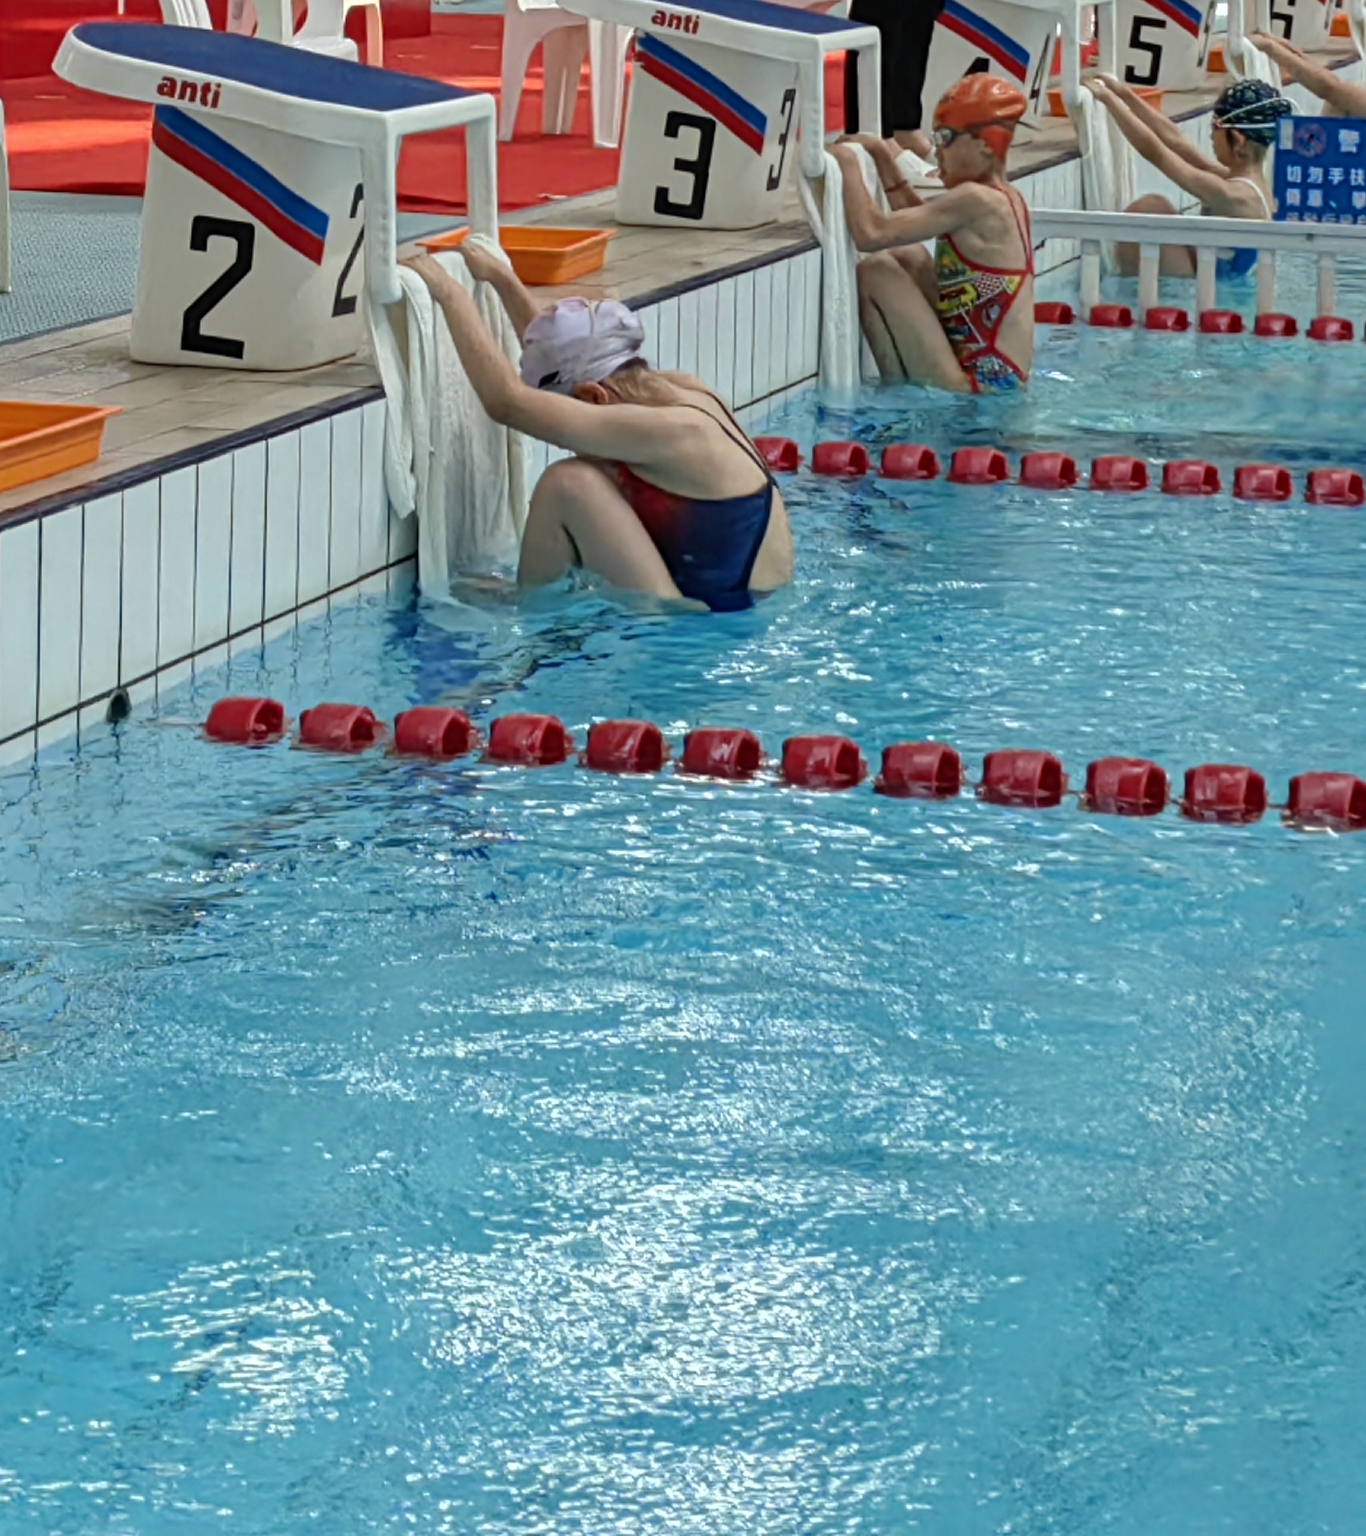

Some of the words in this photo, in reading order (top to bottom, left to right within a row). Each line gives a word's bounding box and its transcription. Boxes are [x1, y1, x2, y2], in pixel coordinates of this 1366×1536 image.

[650, 6, 701, 36] anti
[1125, 14, 1168, 87] 5
[156, 72, 223, 110] anti
[653, 110, 717, 221] 3
[765, 88, 797, 192] 3
[179, 214, 256, 361] 2
